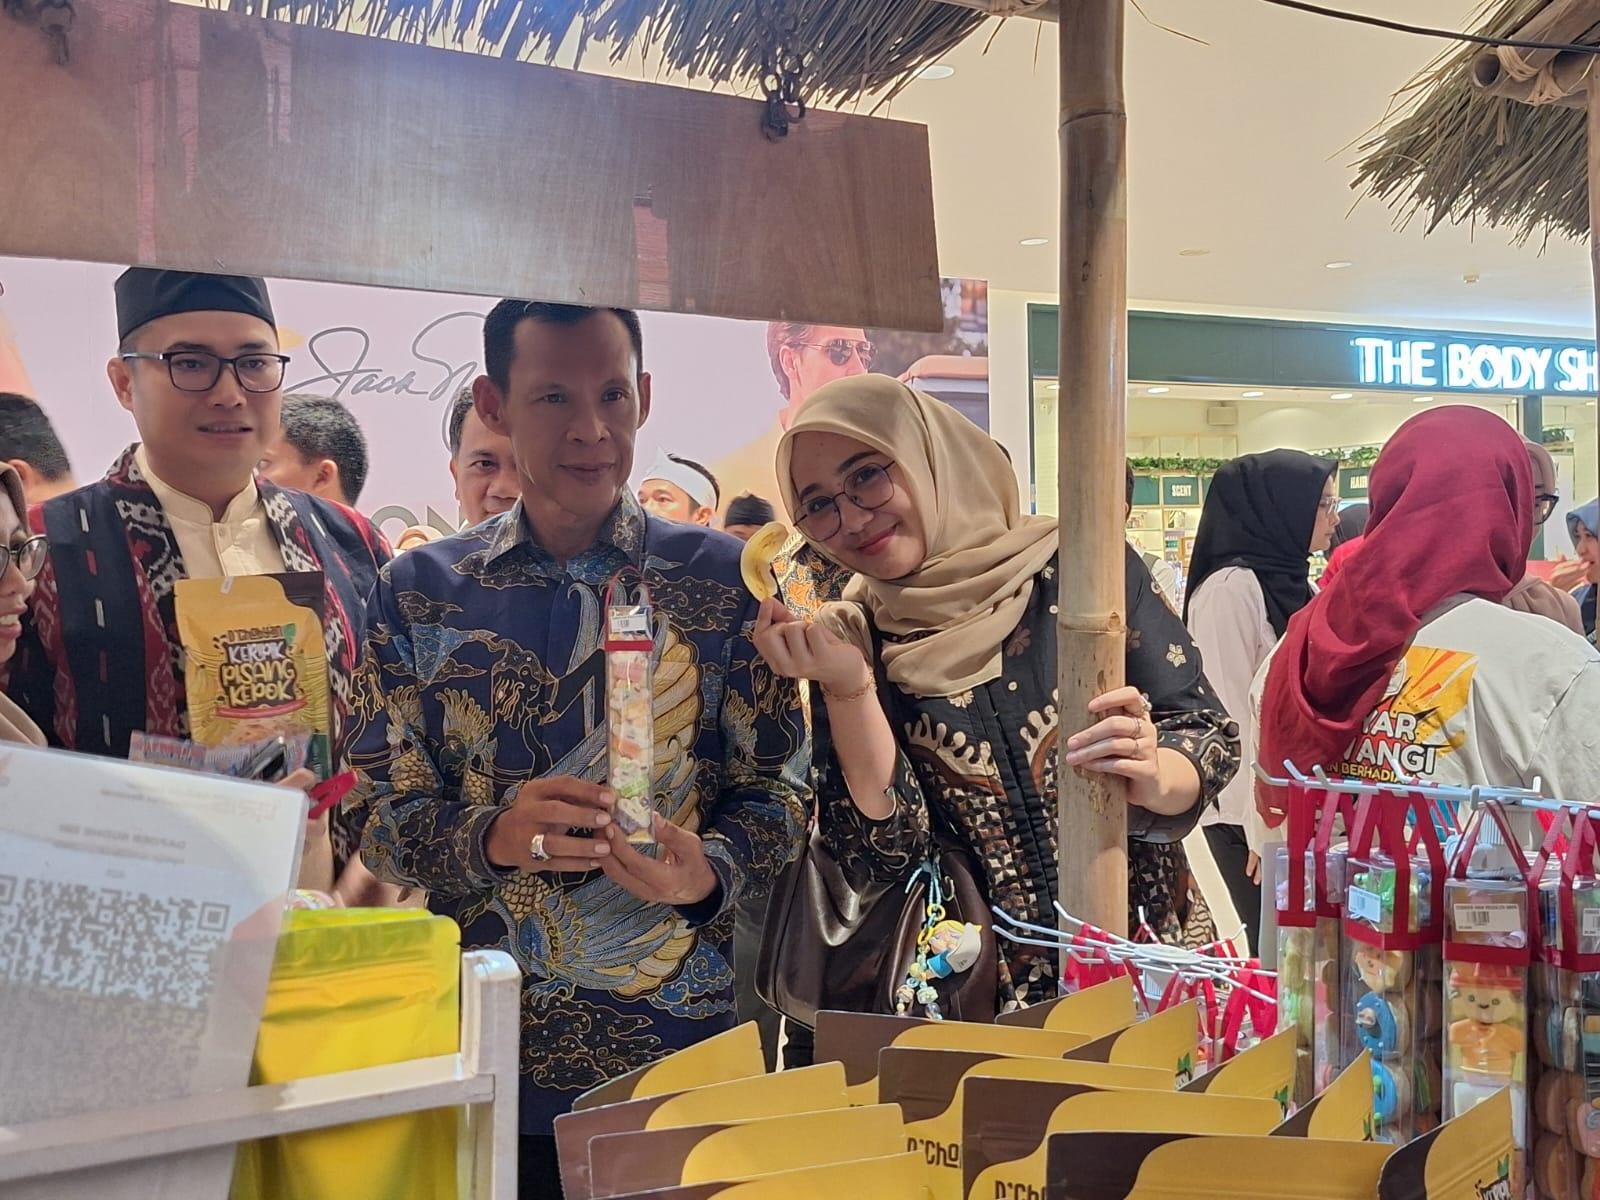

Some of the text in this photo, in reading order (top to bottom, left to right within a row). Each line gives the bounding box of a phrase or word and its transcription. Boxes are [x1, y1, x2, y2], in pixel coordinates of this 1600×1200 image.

[1351, 337, 1437, 386] THE
[1443, 343, 1553, 390] BODY
[1171, 484, 1192, 497] SCENT
[222, 658, 296, 688] PISANG
[228, 680, 293, 706] KEPOK
